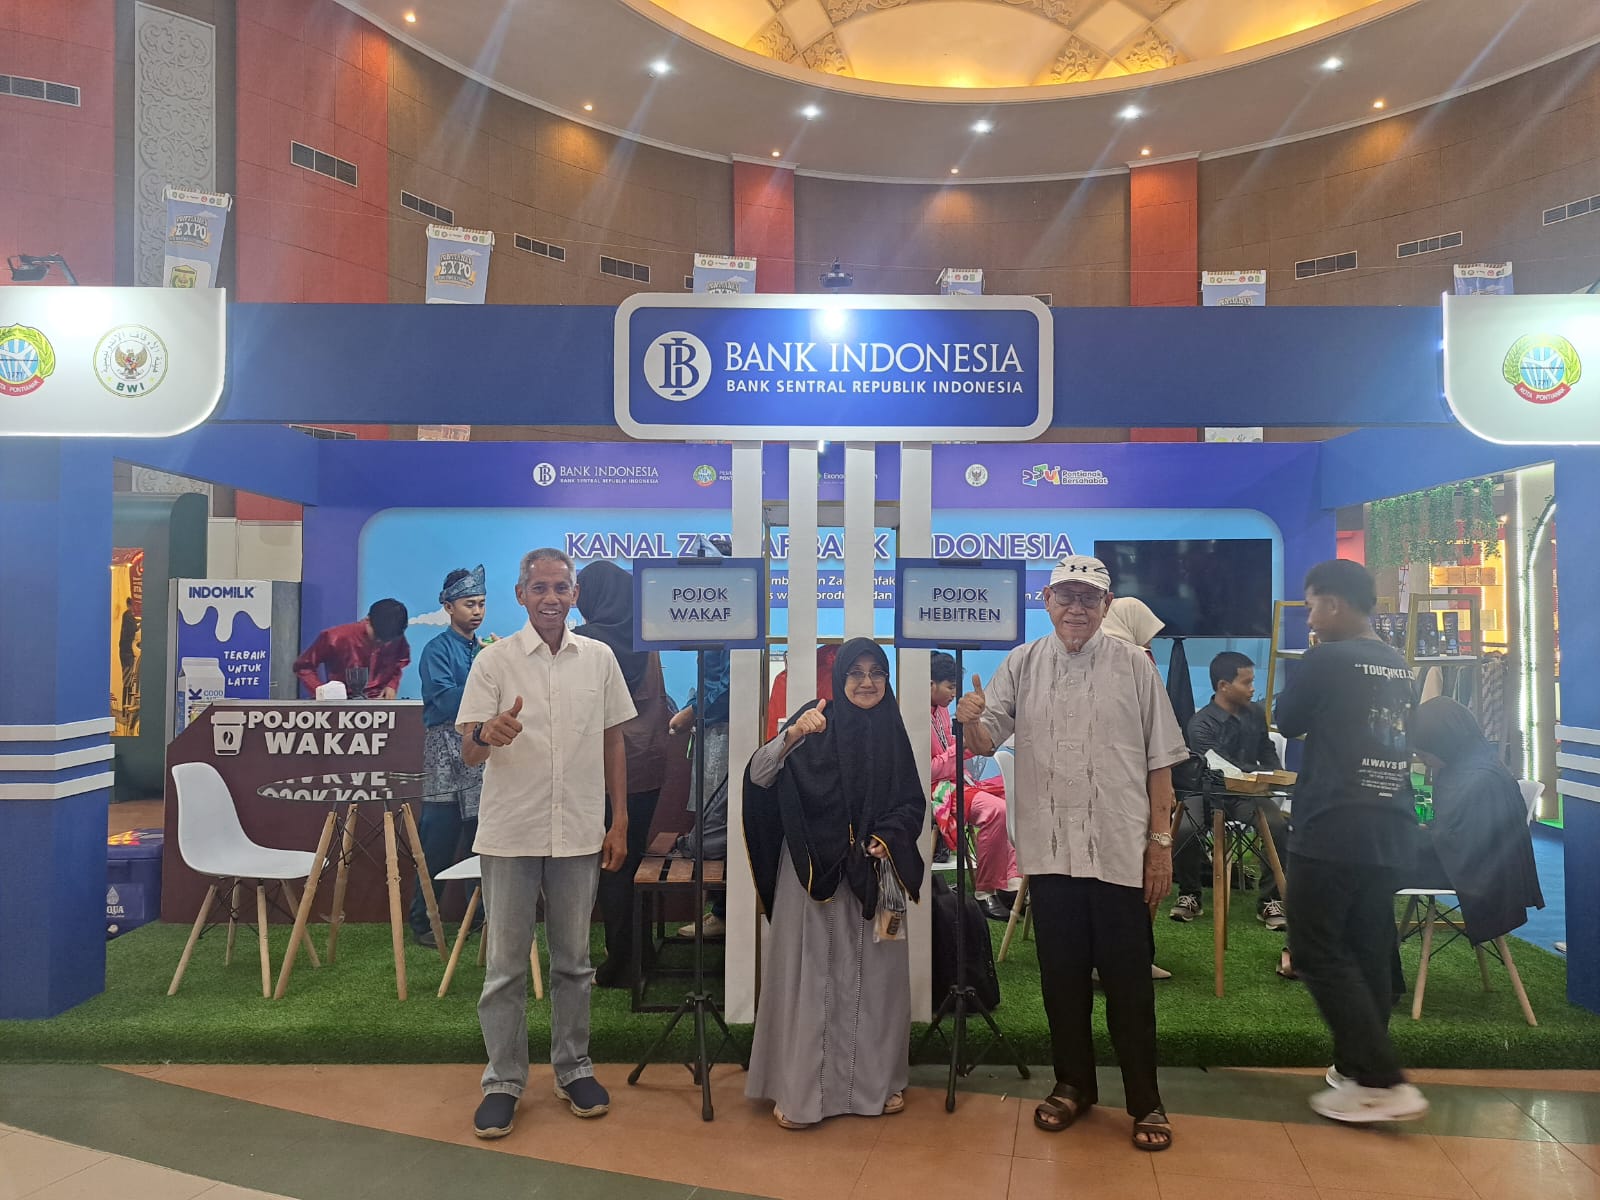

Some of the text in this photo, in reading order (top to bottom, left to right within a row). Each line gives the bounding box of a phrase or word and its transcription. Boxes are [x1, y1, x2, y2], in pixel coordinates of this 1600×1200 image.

[175, 222, 208, 240] EXPO
[439, 260, 472, 278] EXPO
[724, 341, 1025, 374] BANK INDONESIA
[116, 382, 145, 393] BWI
[726, 379, 1023, 394] BANK SENTRAL REPUBLIK INDONESIA
[560, 466, 659, 477] BANK INDONESIA
[1062, 470, 1102, 478] Pontianak
[1062, 477, 1108, 485] Bersahabat
[565, 533, 672, 559] KANAL
[932, 533, 1074, 559] DONESIA
[189, 586, 254, 599] INDOMILK
[672, 587, 729, 602] POJOK
[933, 587, 989, 602] POJOK
[669, 607, 732, 622] WAKAF
[919, 606, 1001, 622] HEBITREN
[224, 650, 266, 660] TERBAIK
[227, 664, 262, 674] UNTUK
[227, 677, 260, 687] LATTE
[248, 711, 395, 729] POJOK KOPI
[264, 732, 388, 755] WAKAF
[1361, 758, 1397, 769] ALWAYS
[107, 906, 124, 914] QUA
